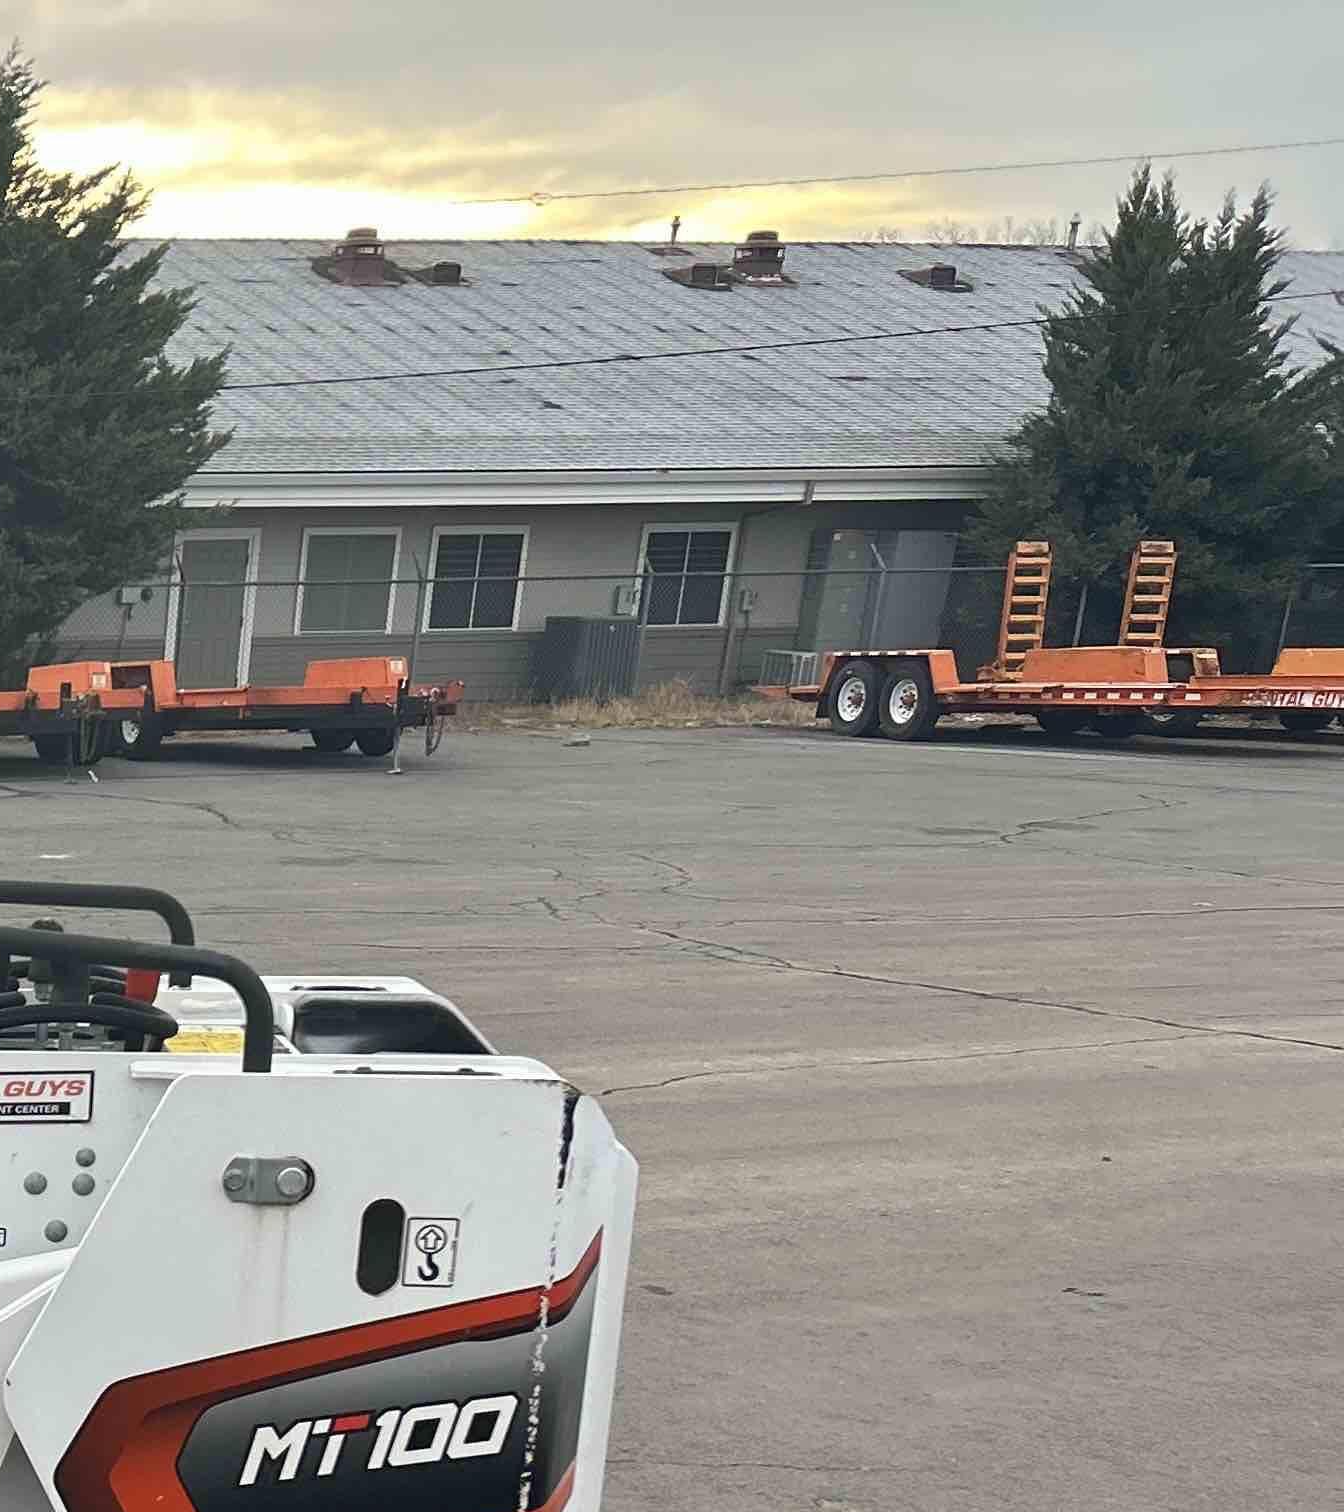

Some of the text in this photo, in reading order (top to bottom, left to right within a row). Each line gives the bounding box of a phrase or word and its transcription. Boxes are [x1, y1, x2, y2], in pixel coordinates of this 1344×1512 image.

[3, 1079, 86, 1097] GUYS
[15, 1103, 60, 1114] CENTER
[238, 1394, 519, 1486] MT100
